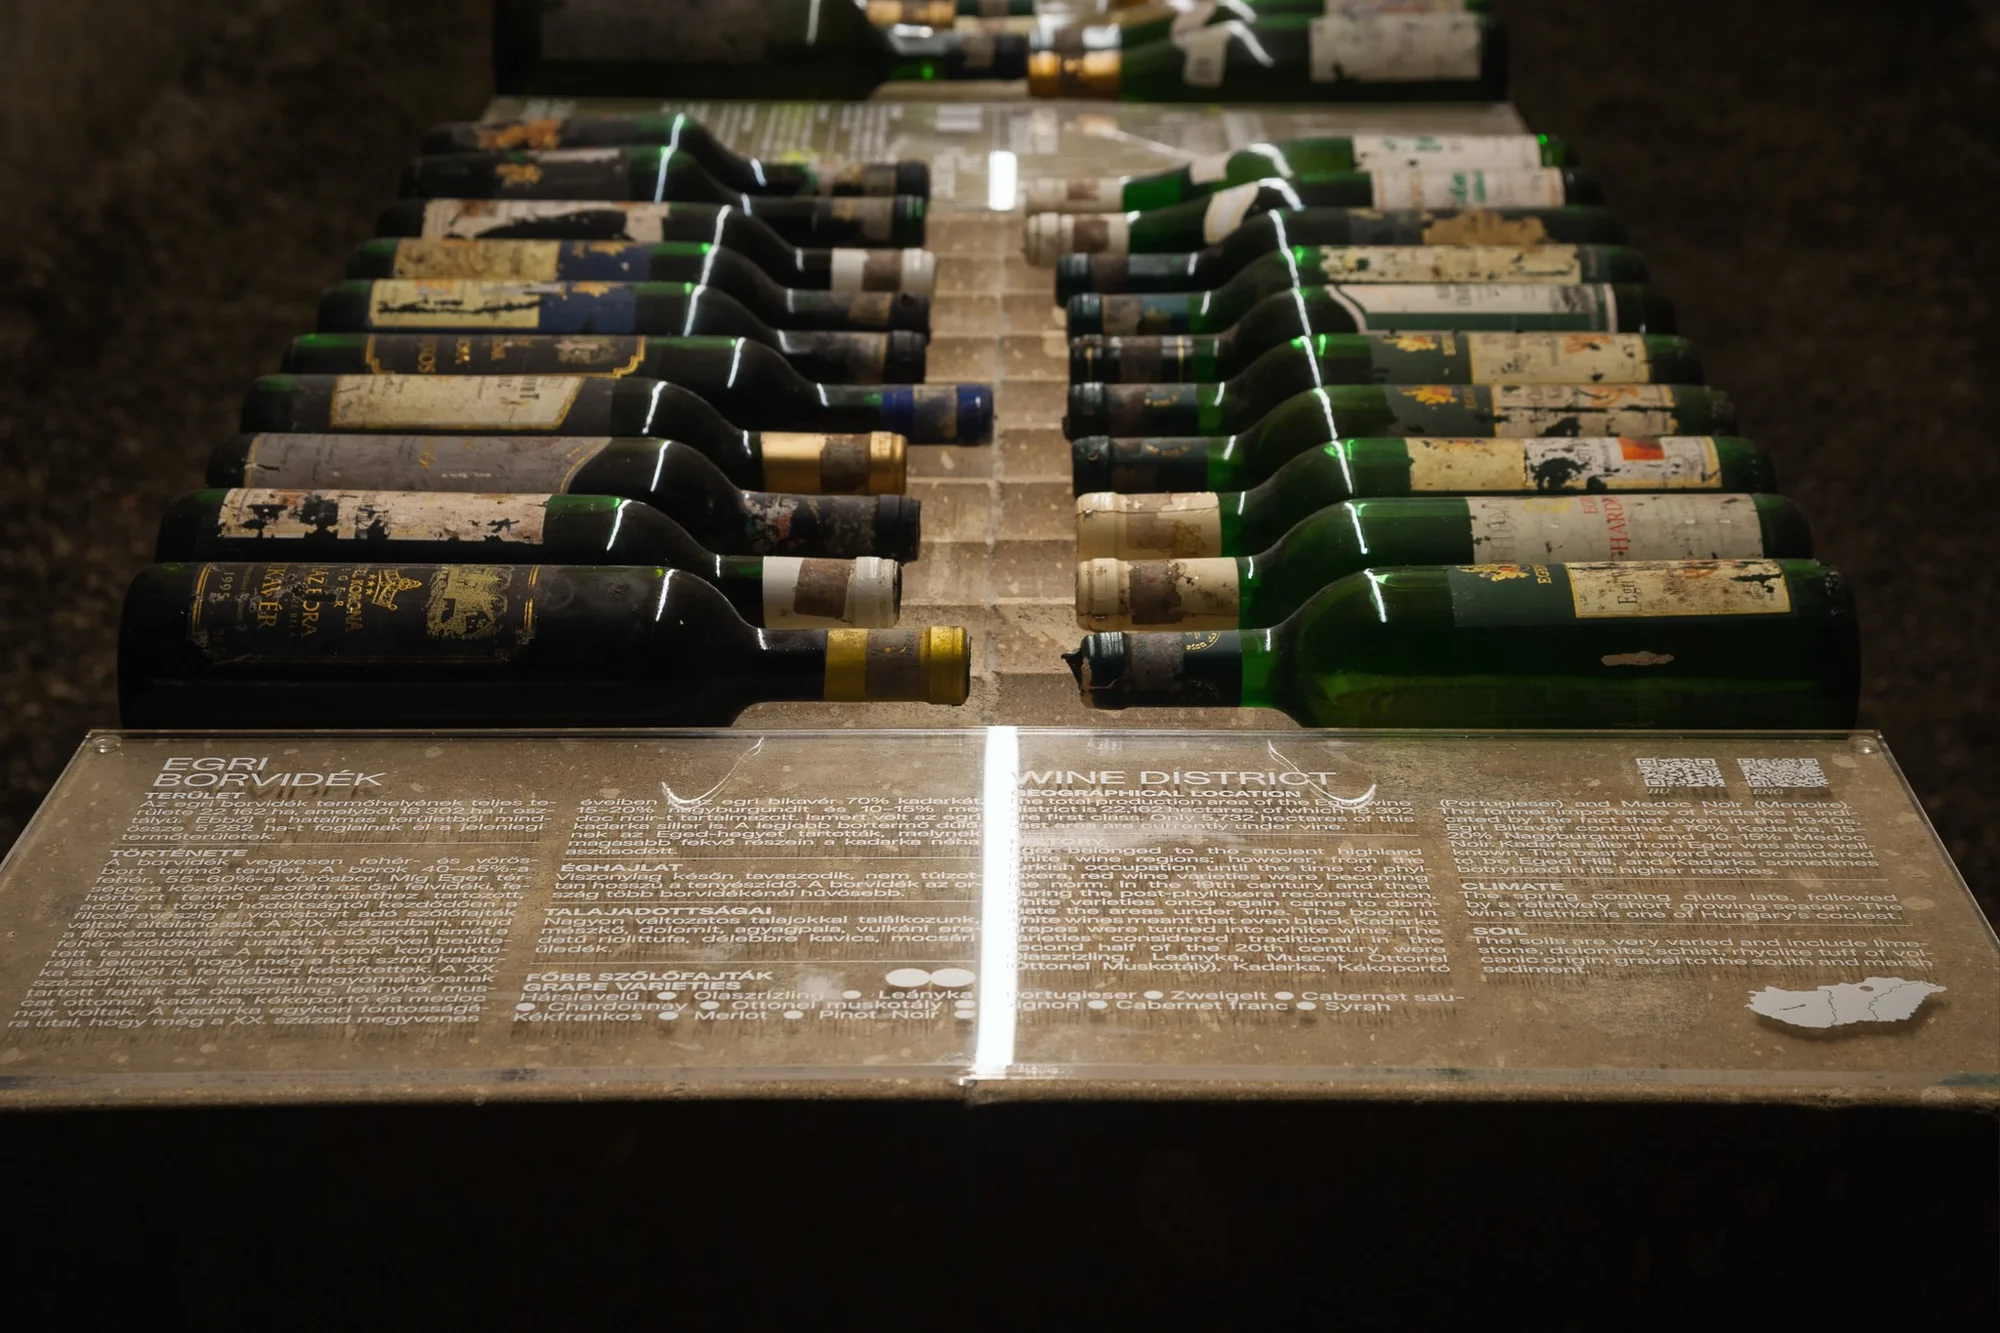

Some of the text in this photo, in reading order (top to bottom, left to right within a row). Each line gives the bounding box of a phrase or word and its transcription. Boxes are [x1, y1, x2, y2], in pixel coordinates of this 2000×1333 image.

[163, 757, 267, 770] EGRI
[154, 769, 385, 786] BORVIDÉK
[1011, 771, 1338, 784] WINE DISTRICT
[142, 790, 245, 799] TERÜLET
[173, 800, 213, 808] egri
[316, 799, 463, 807] termőhelyének
[471, 798, 523, 807] teljes
[1439, 799, 1564, 808] (Portugieser)
[1753, 800, 1851, 808] (Menoire),
[231, 807, 267, 815] 162
[271, 807, 299, 816] ha,
[304, 807, 393, 816] amelyből
[425, 806, 465, 814] 302
[1076, 804, 1092, 812] is
[1100, 804, 1162, 813] 22,162
[1168, 804, 1258, 814] hectares,
[1262, 805, 1282, 813] of
[1285, 805, 1345, 813] which
[130, 816, 183, 825] tályú.
[1201, 814, 1254, 822] 5,732
[312, 823, 403, 832] foglalnak
[459, 822, 543, 831] jelenlegi
[108, 848, 247, 856] TÖRTÉNETE
[137, 857, 230, 865] borvidék
[358, 856, 421, 864] fehér-
[436, 856, 460, 864] és
[560, 862, 682, 871] ÉGHAJLAT
[554, 872, 662, 882] Viszonylag
[744, 871, 854, 880] tavaszodik,
[1460, 882, 1564, 890] CLIMATE
[551, 890, 599, 899] szág
[605, 889, 653, 897] több
[1513, 891, 1578, 900] spring
[1591, 892, 1673, 901] coming
[1683, 892, 1737, 901] quite
[1750, 893, 1794, 901] late,
[1806, 893, 1897, 901] followed
[543, 906, 771, 915] TALAJADOTTSÁGAI
[1466, 908, 1516, 916] wine
[1522, 909, 1596, 917] district
[1599, 909, 1620, 917] is
[1672, 910, 1694, 918] of
[1815, 911, 1900, 919] coolest.
[543, 916, 624, 926] Nagyon
[635, 915, 740, 924] változatos
[750, 915, 847, 925] talajokkal
[541, 926, 629, 935] mészkő,
[639, 925, 724, 934] dolomit,
[734, 924, 845, 934] agyagpala,
[855, 924, 928, 932] vulkáni
[1470, 936, 1512, 944] The
[1518, 936, 1565, 944] soils
[1612, 939, 1660, 947] very
[1665, 937, 1733, 945] varied
[1739, 938, 1780, 946] and
[1786, 938, 1867, 946] include
[1873, 939, 1928, 947] lime-
[1482, 964, 1589, 972] sediment.
[526, 970, 772, 981] FŐBB SZŐLŐFAJTÁK
[522, 981, 741, 991] GRAPE VARIETIES
[520, 992, 639, 1000] Hárslevelű
[1170, 989, 1267, 1002] Zweigelt
[1301, 991, 1407, 1000] Cabernet
[547, 999, 942, 1012] Chardonnay Ottonel muskotály
[1116, 999, 1222, 1009] Cabernet
[1229, 1000, 1288, 1009] franc
[1325, 1000, 1390, 1013] Syrah
[511, 1008, 939, 1020] Kékfrankos Merlot Pinot Noir
[35, 1017, 83, 1027] utal,
[88, 1017, 146, 1028] hogy
[152, 1016, 204, 1027] még
[230, 1015, 268, 1024] XX.
[273, 1014, 350, 1023] század
[356, 1015, 479, 1024] negyvenes
